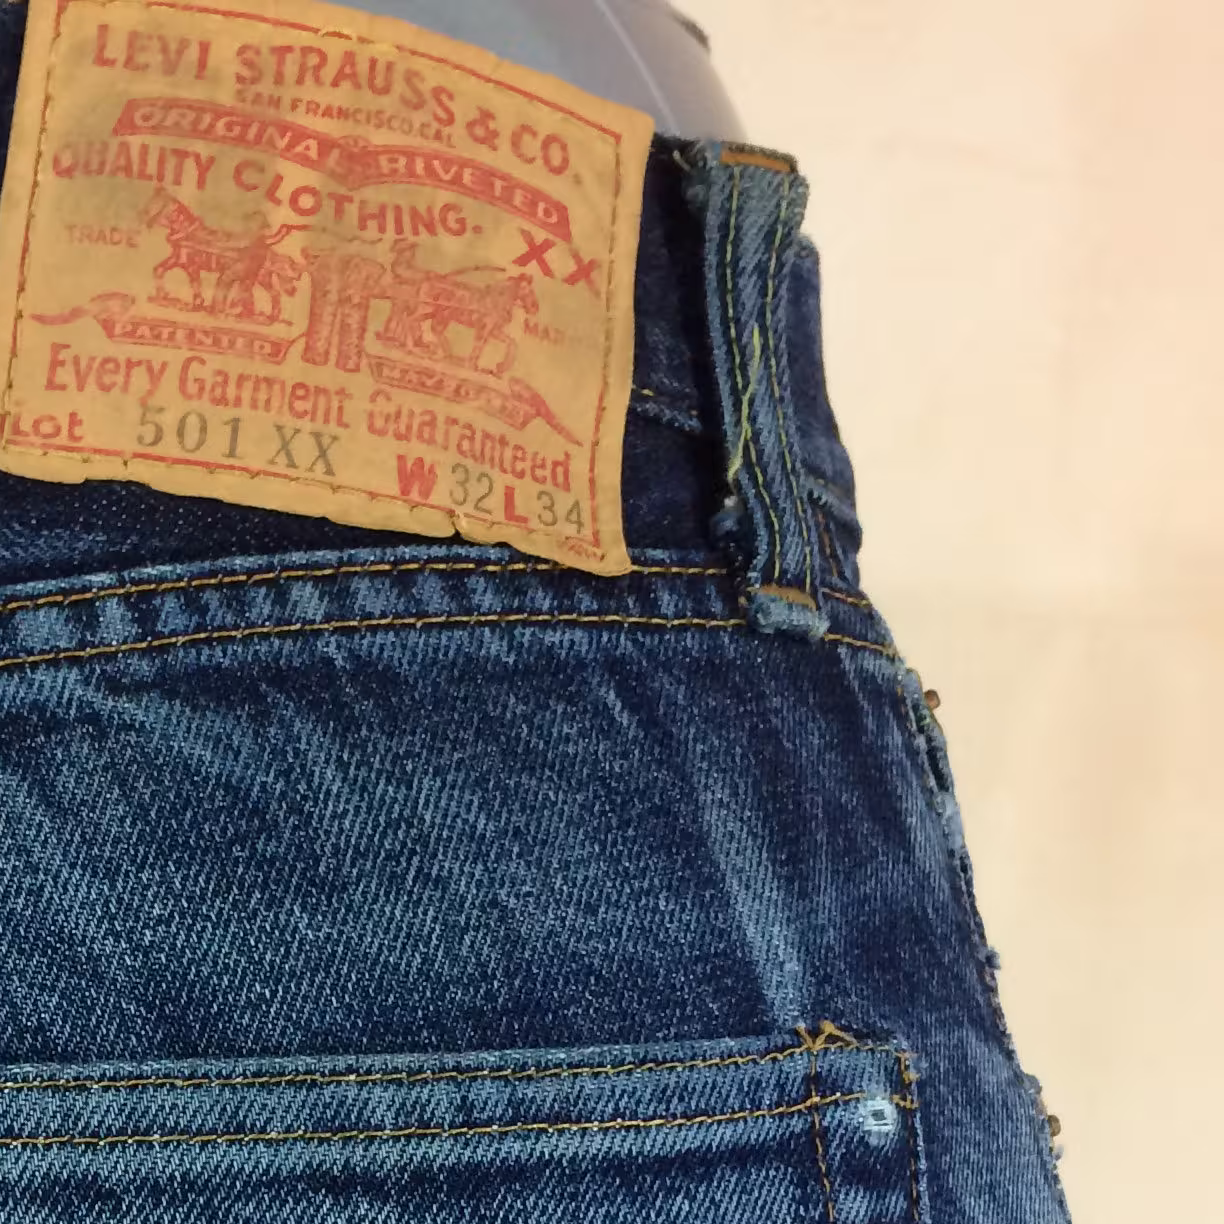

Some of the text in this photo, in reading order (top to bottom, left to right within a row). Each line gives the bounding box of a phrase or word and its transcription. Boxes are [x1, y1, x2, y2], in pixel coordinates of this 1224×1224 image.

[93, 23, 211, 80] LEVI
[234, 44, 456, 127] STRAUSS
[53, 141, 217, 191] QUALITY
[133, 104, 558, 224] ORIGINAL RIVETED
[63, 224, 141, 249] TRADE
[114, 320, 272, 355] PATENTED
[44, 342, 168, 408] Every
[178, 355, 354, 430] Garment
[366, 388, 572, 493] Guaranteed
[137, 405, 242, 459] 501
[268, 424, 341, 478] XX
[396, 453, 438, 501] W
[449, 462, 494, 516] 32
[503, 485, 529, 524] L
[536, 490, 585, 535] 34
